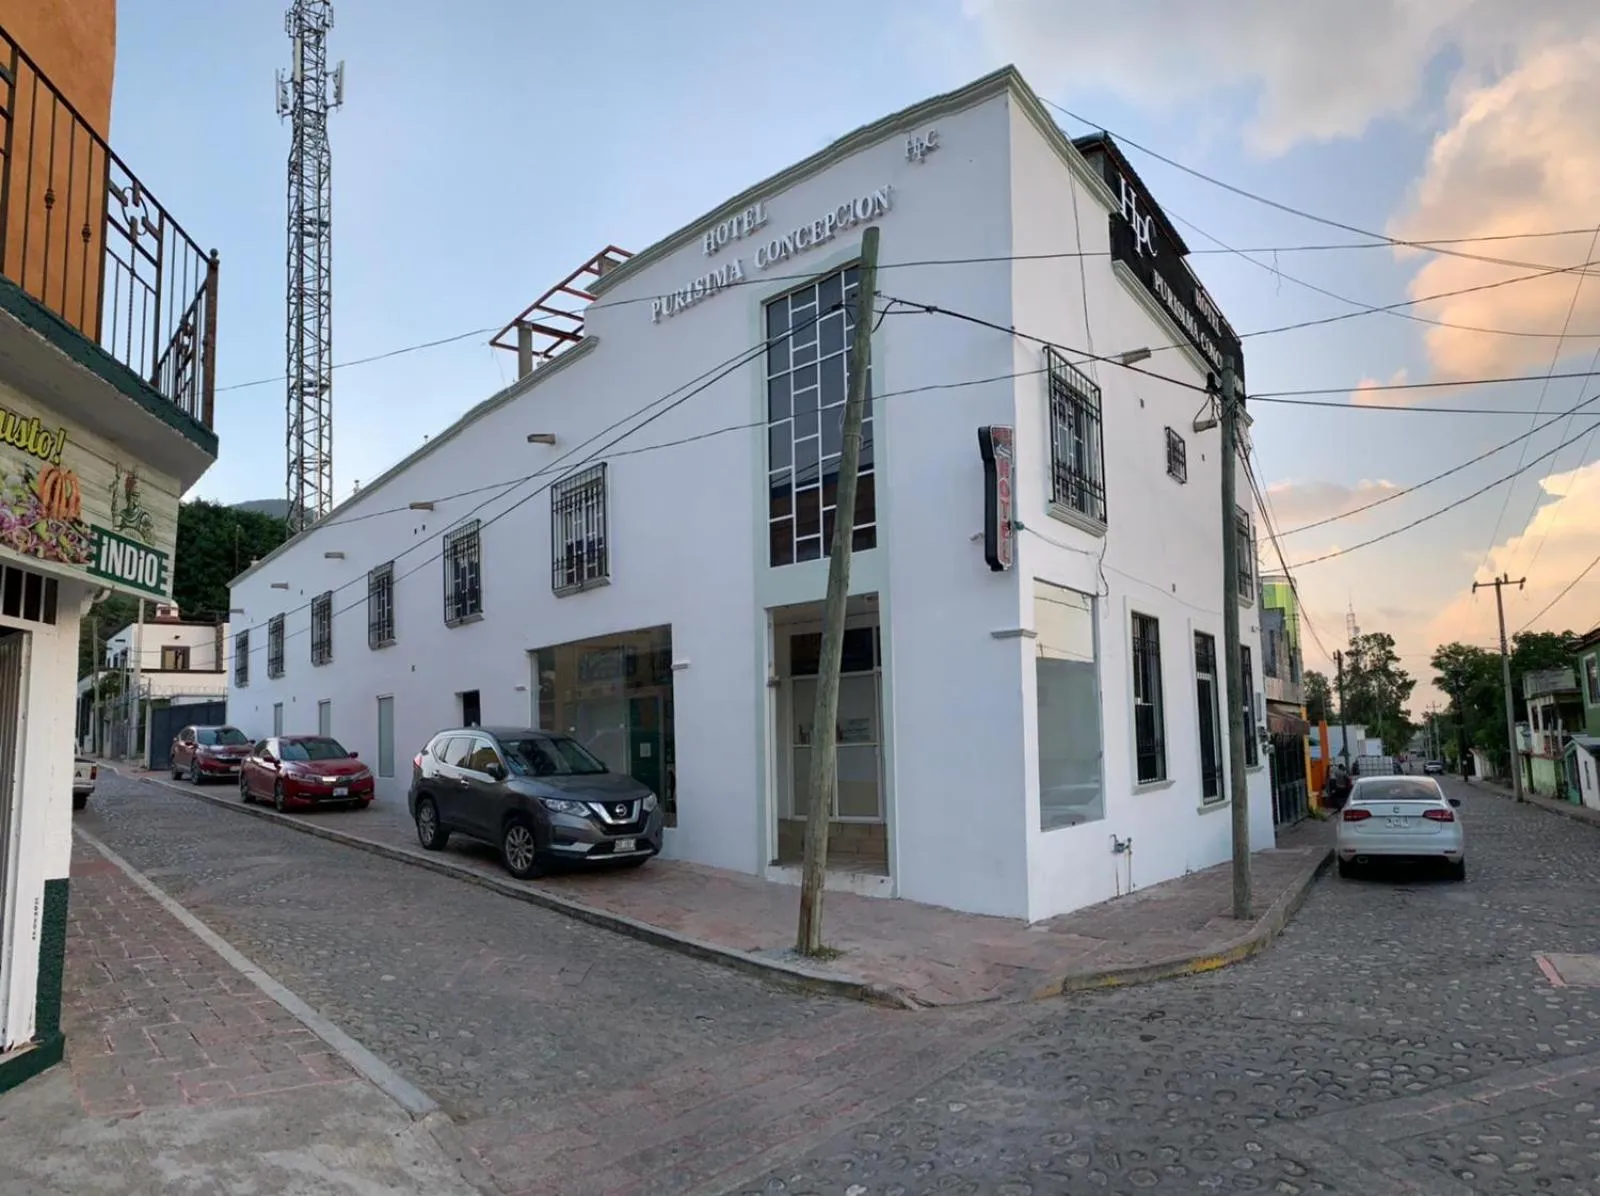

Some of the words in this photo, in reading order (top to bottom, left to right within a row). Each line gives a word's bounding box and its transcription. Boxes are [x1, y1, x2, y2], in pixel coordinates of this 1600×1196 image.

[650, 258, 745, 321] PURISIMA
[755, 184, 894, 270] CONCEPCION
[703, 201, 769, 255] HOTEL
[1153, 268, 1199, 343] PURISIMA
[1195, 286, 1221, 337] HOTEL
